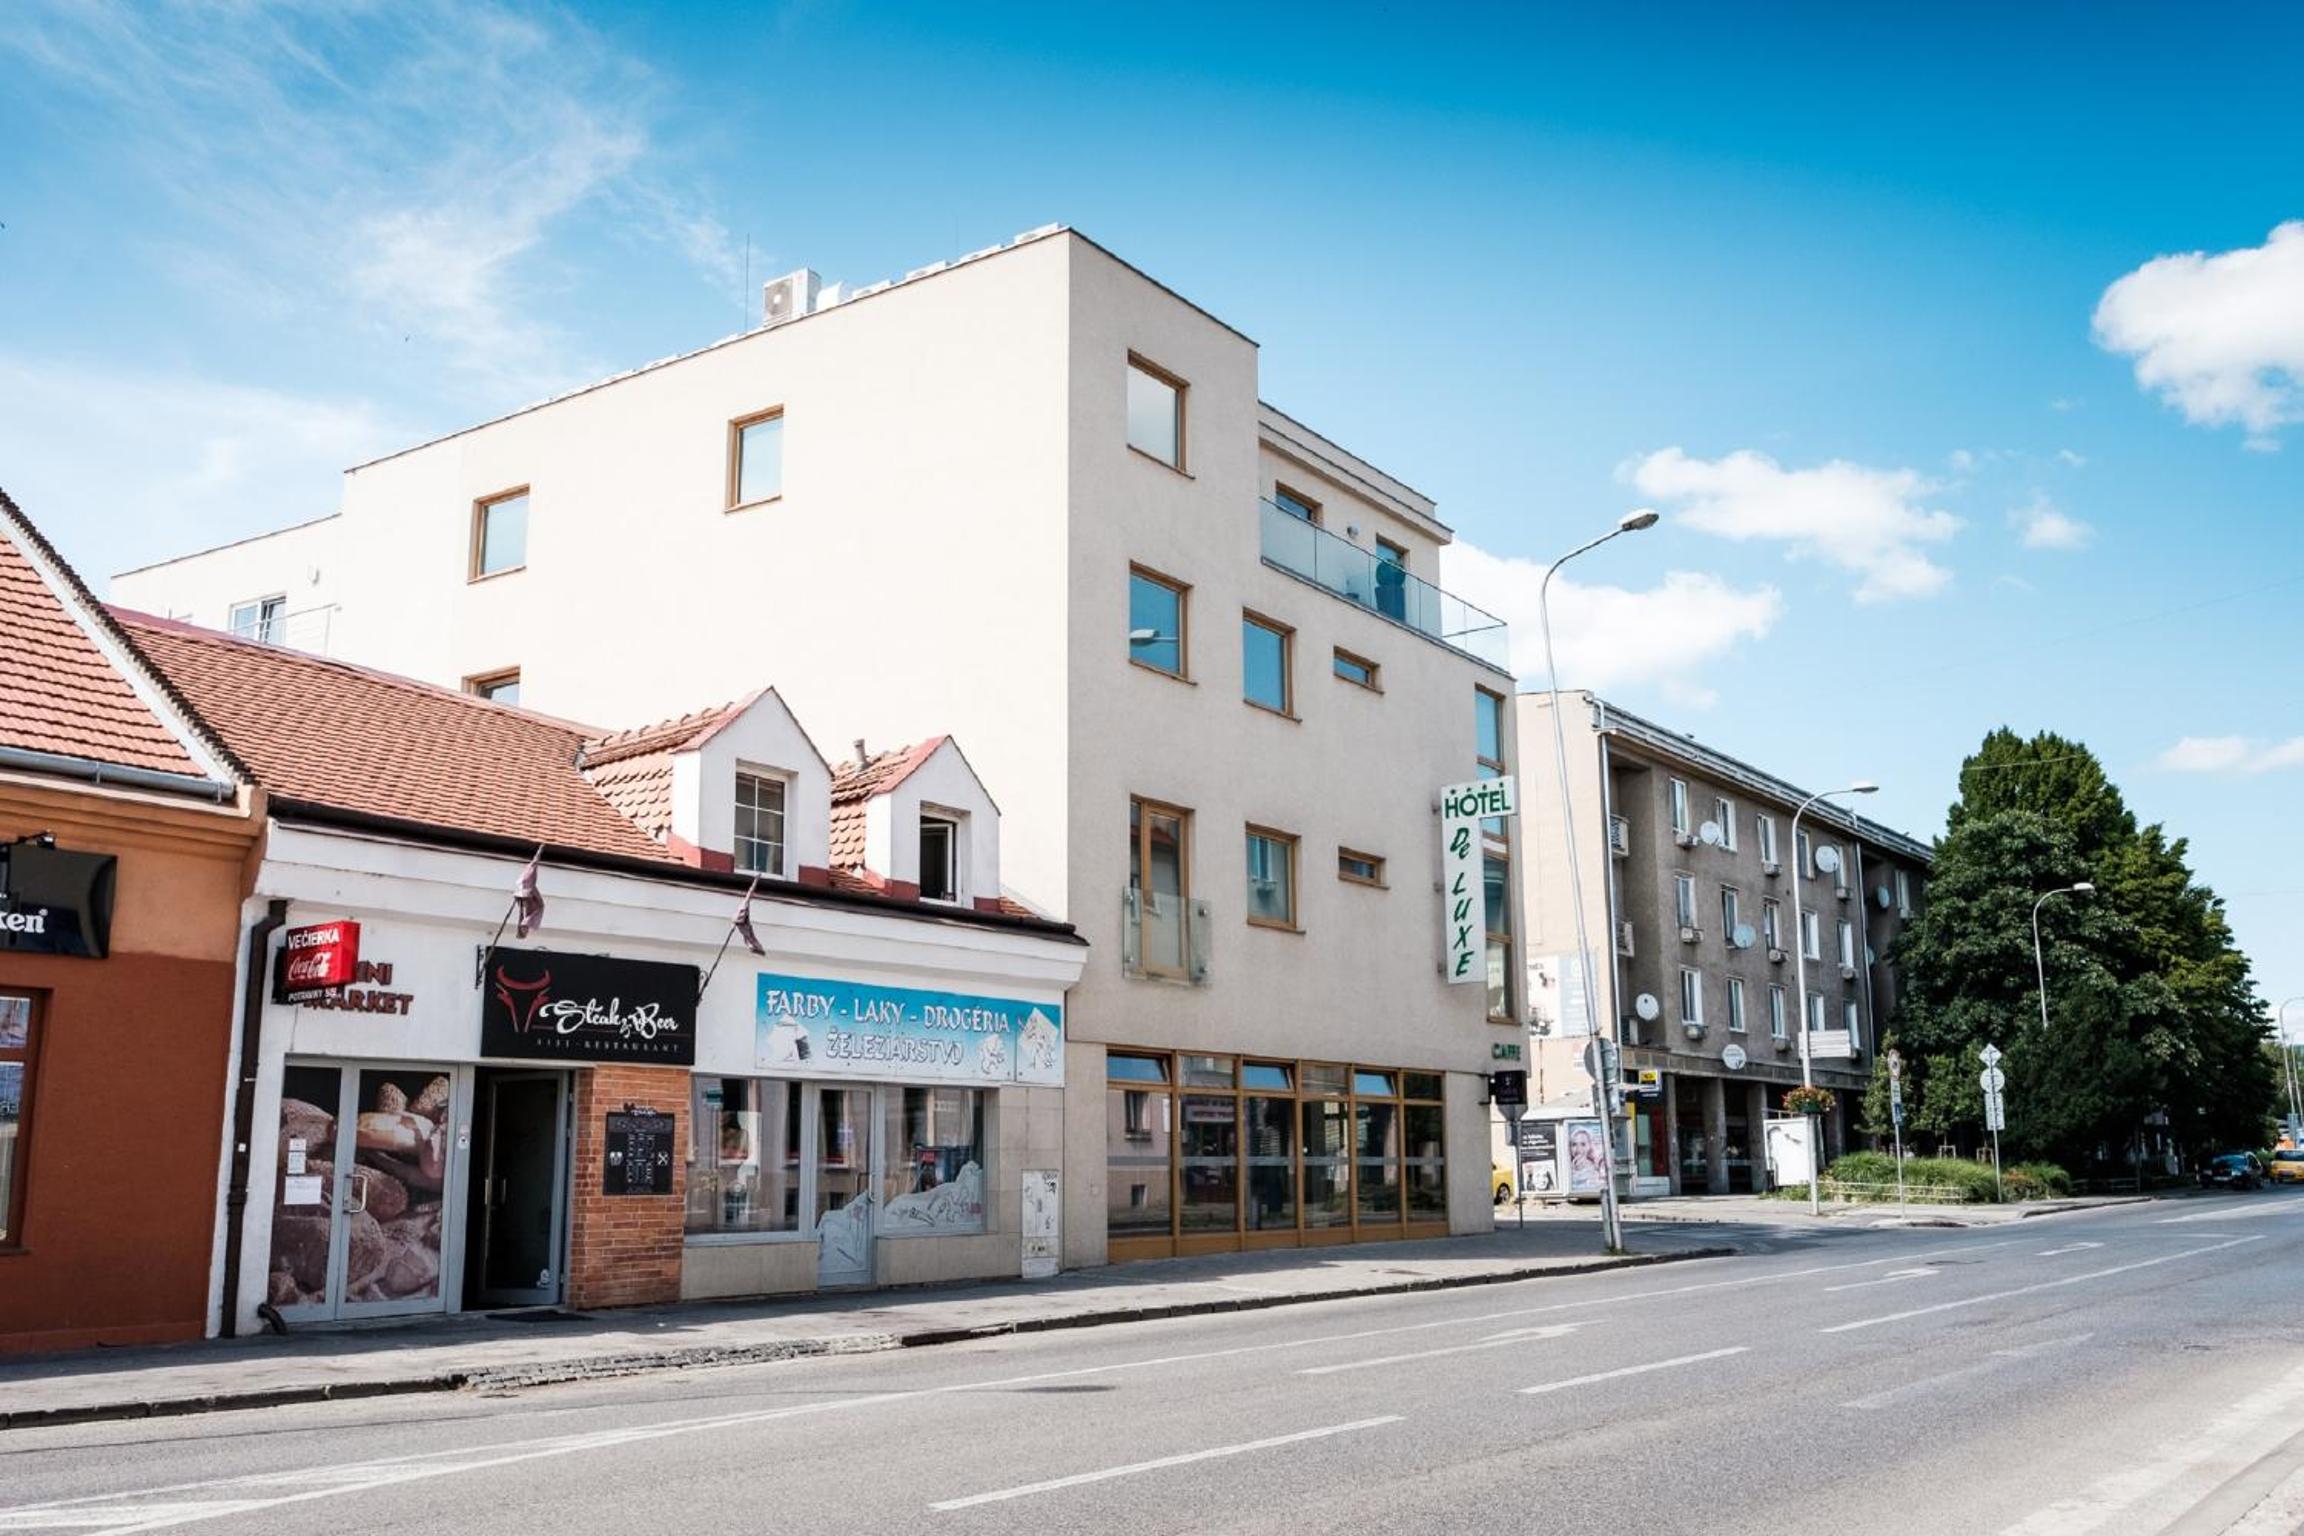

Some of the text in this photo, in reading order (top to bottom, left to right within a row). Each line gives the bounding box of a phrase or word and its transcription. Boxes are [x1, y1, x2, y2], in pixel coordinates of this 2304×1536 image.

[1445, 790, 1511, 819] HOTEL
[288, 927, 340, 950] VEČIERKA
[540, 997, 620, 1035] Steak
[628, 1002, 679, 1039] Beer
[766, 989, 836, 1019] FARBY
[854, 998, 906, 1025] LAKY
[923, 1004, 1011, 1034] DROGÉRIA
[825, 1025, 964, 1066] ŽELEZIARSTVO
